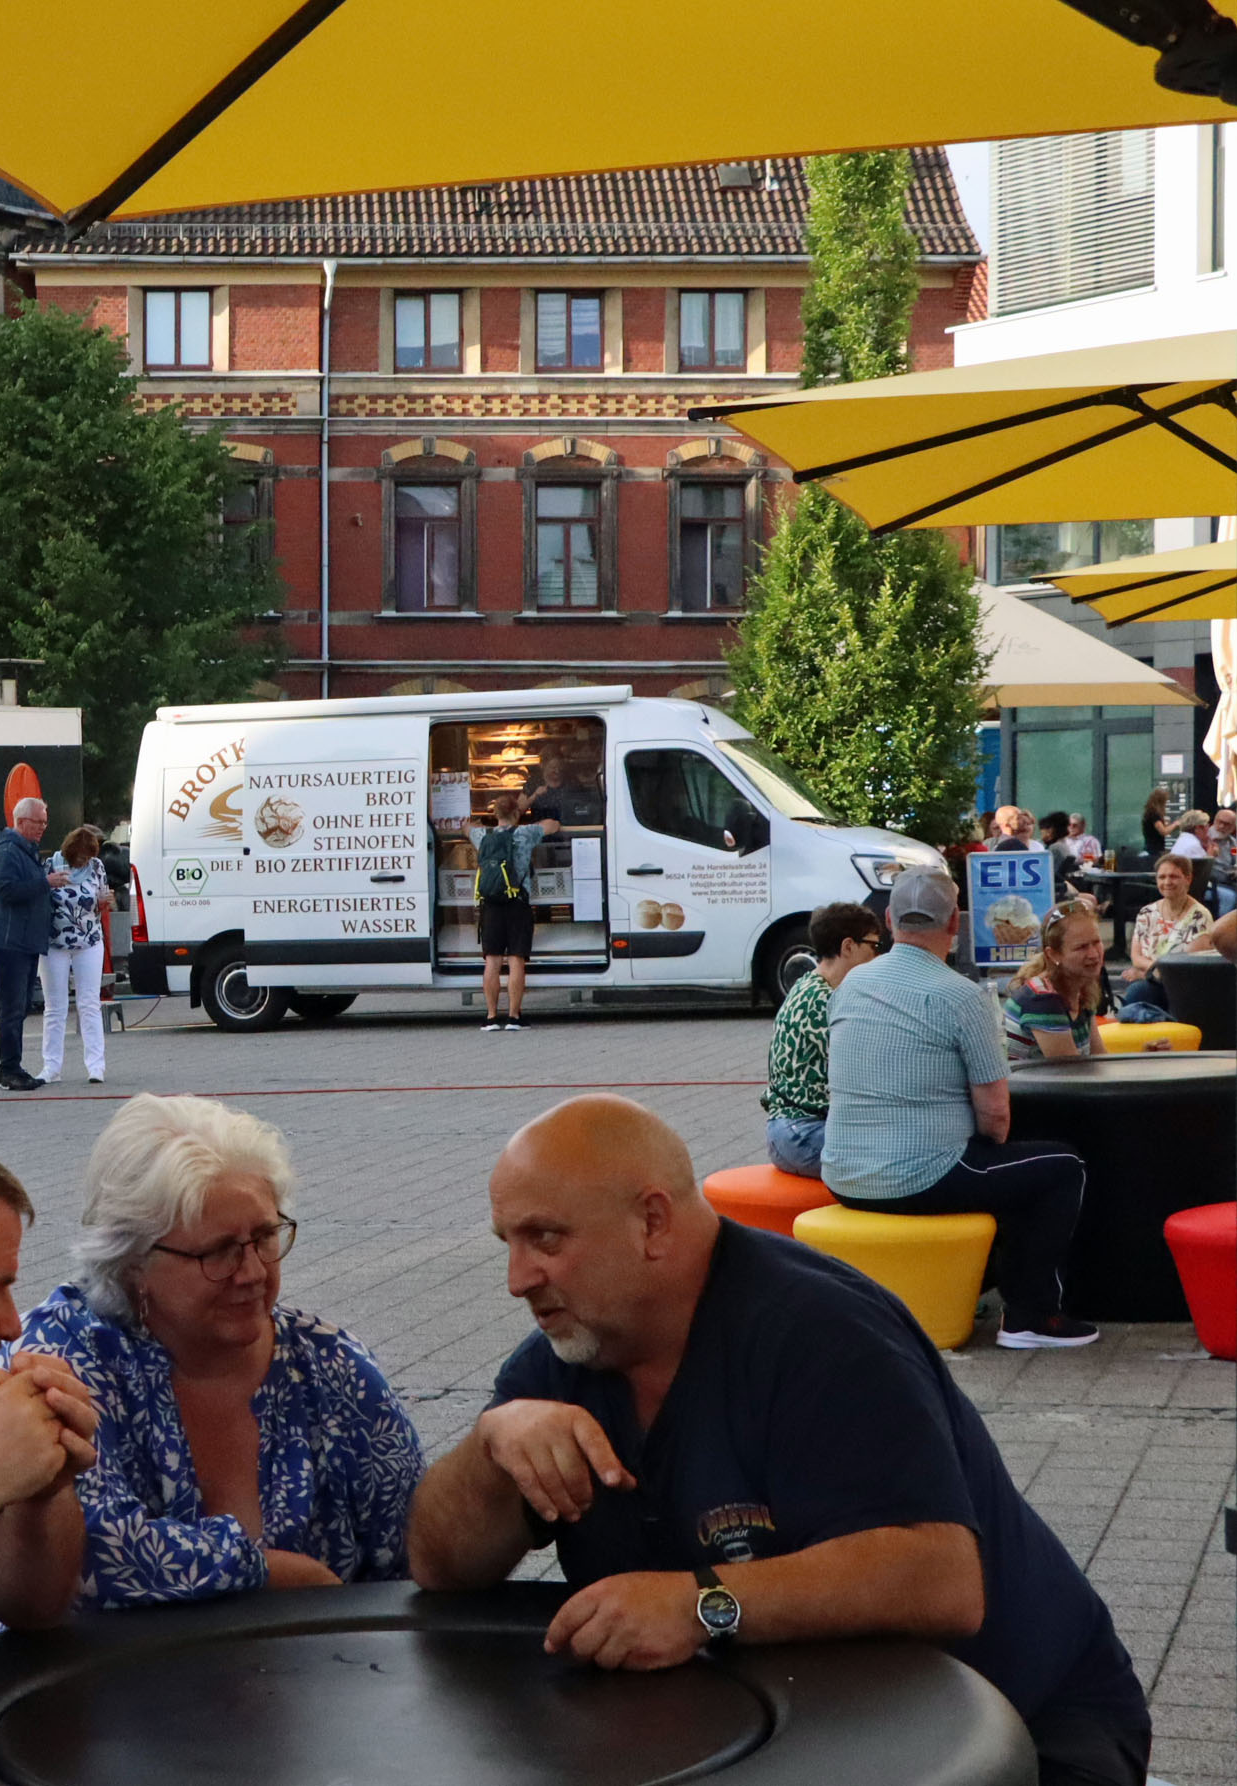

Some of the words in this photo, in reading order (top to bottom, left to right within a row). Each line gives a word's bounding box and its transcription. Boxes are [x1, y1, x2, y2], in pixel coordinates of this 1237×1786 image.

[249, 769, 416, 790] NATURSAUERTEIG
[365, 791, 416, 807] BROT
[313, 814, 364, 830] OHNE
[369, 812, 416, 828] HEFE
[313, 834, 415, 851] STEINOFEN
[210, 860, 233, 872] DIE
[255, 859, 286, 874] BIO
[291, 855, 415, 873] ZERTIFIZIERT
[979, 859, 1042, 888] EIS
[253, 896, 417, 914] ENERGETISIERTES
[341, 918, 417, 934] WASSER
